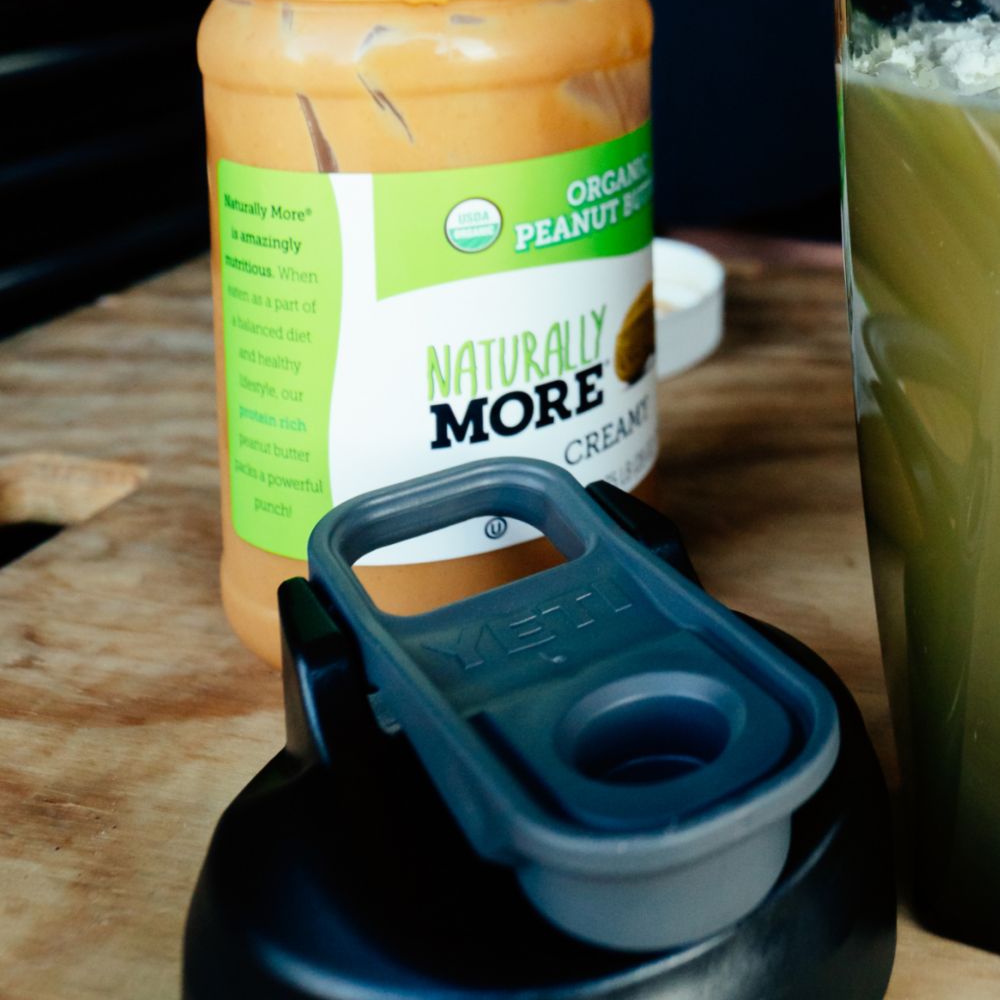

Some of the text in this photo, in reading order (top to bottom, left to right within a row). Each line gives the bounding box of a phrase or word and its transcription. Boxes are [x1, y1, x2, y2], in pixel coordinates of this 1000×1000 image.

[224, 193, 267, 220] Naturally
[458, 210, 489, 224] USDA
[515, 198, 619, 252] PEANUT
[231, 228, 301, 254] is amazingly
[225, 255, 318, 284] nutritious. When
[252, 292, 263, 304] as
[265, 296, 272, 308] a
[275, 296, 298, 313] part
[303, 300, 317, 314] of
[237, 318, 283, 341] balanced
[287, 327, 312, 344] diet
[239, 348, 301, 376] and healthy
[426, 305, 606, 400] NATURALLY
[282, 390, 303, 402] our
[430, 362, 604, 450] MORE
[239, 405, 307, 432] protein rich
[564, 396, 649, 465] CREAMY
[239, 434, 309, 463] peanut butter
[268, 472, 323, 494] powerful
[254, 498, 292, 519] punch!
[421, 578, 632, 669] YETI
